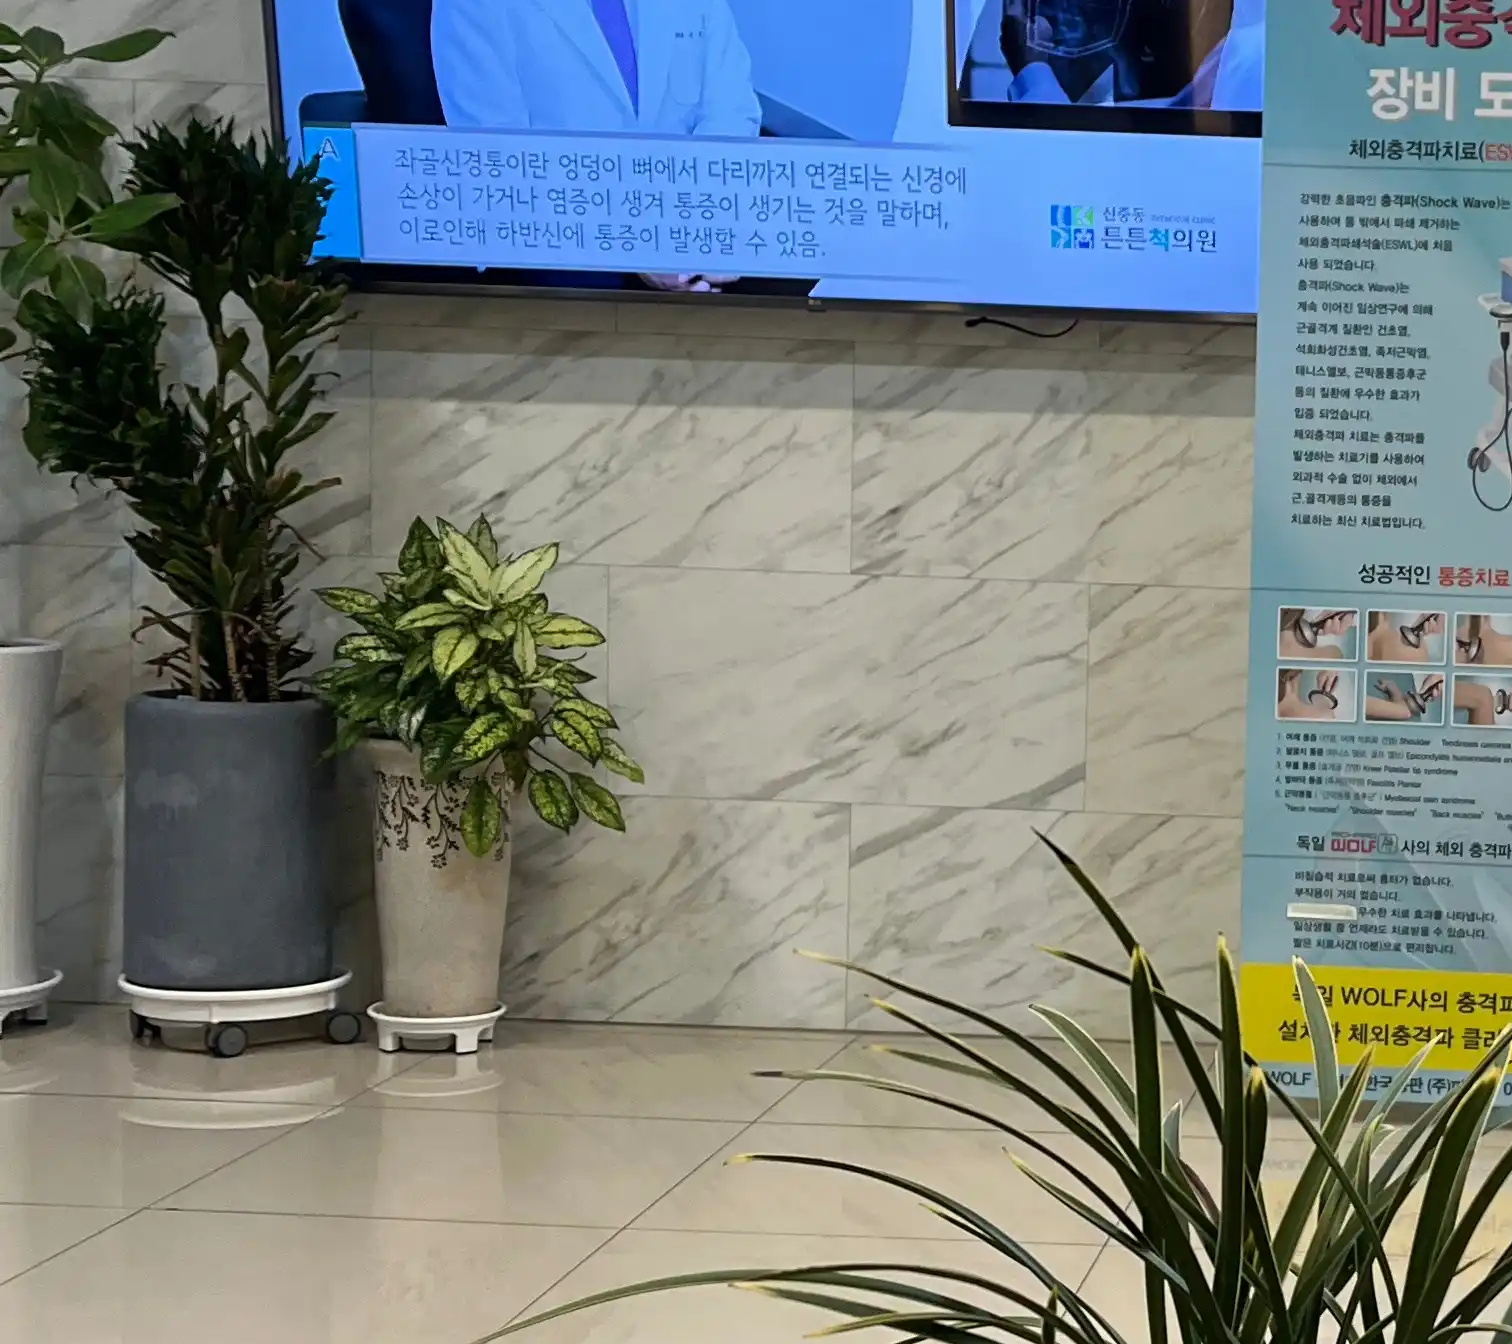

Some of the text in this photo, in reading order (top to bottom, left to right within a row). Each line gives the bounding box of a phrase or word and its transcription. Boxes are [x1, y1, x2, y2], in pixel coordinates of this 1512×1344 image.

[1366, 68, 1457, 121] 장비
[395, 148, 966, 195] 좌골신경통이란 엉덩이 뼈에서 다리까지 연결되는 신경에
[399, 184, 948, 230] 손상이 가거나 염증이 생겨 통증이 생기는 것을 말하며,
[1103, 207, 1144, 223] 신중동
[1300, 215, 1340, 227] 사용하여
[400, 217, 825, 257] 이로인해 하반신에 통증이 발생할 수 있음.
[1101, 226, 1216, 253] 튼튼척의원
[1322, 302, 1408, 315] 이어진 임상연구에
[1383, 454, 1425, 465] 사용하여
[1291, 514, 1332, 526] 치료하는
[1357, 563, 1431, 587] 성공적인
[1438, 566, 1511, 589] 통증치료
[1296, 836, 1325, 851] 독일
[1401, 840, 1430, 856] 사의
[1436, 842, 1464, 857] 체외
[1469, 842, 1511, 858] 충격파
[1342, 987, 1448, 1011] WOLF사의
[1348, 1023, 1454, 1047] 체외충격파
